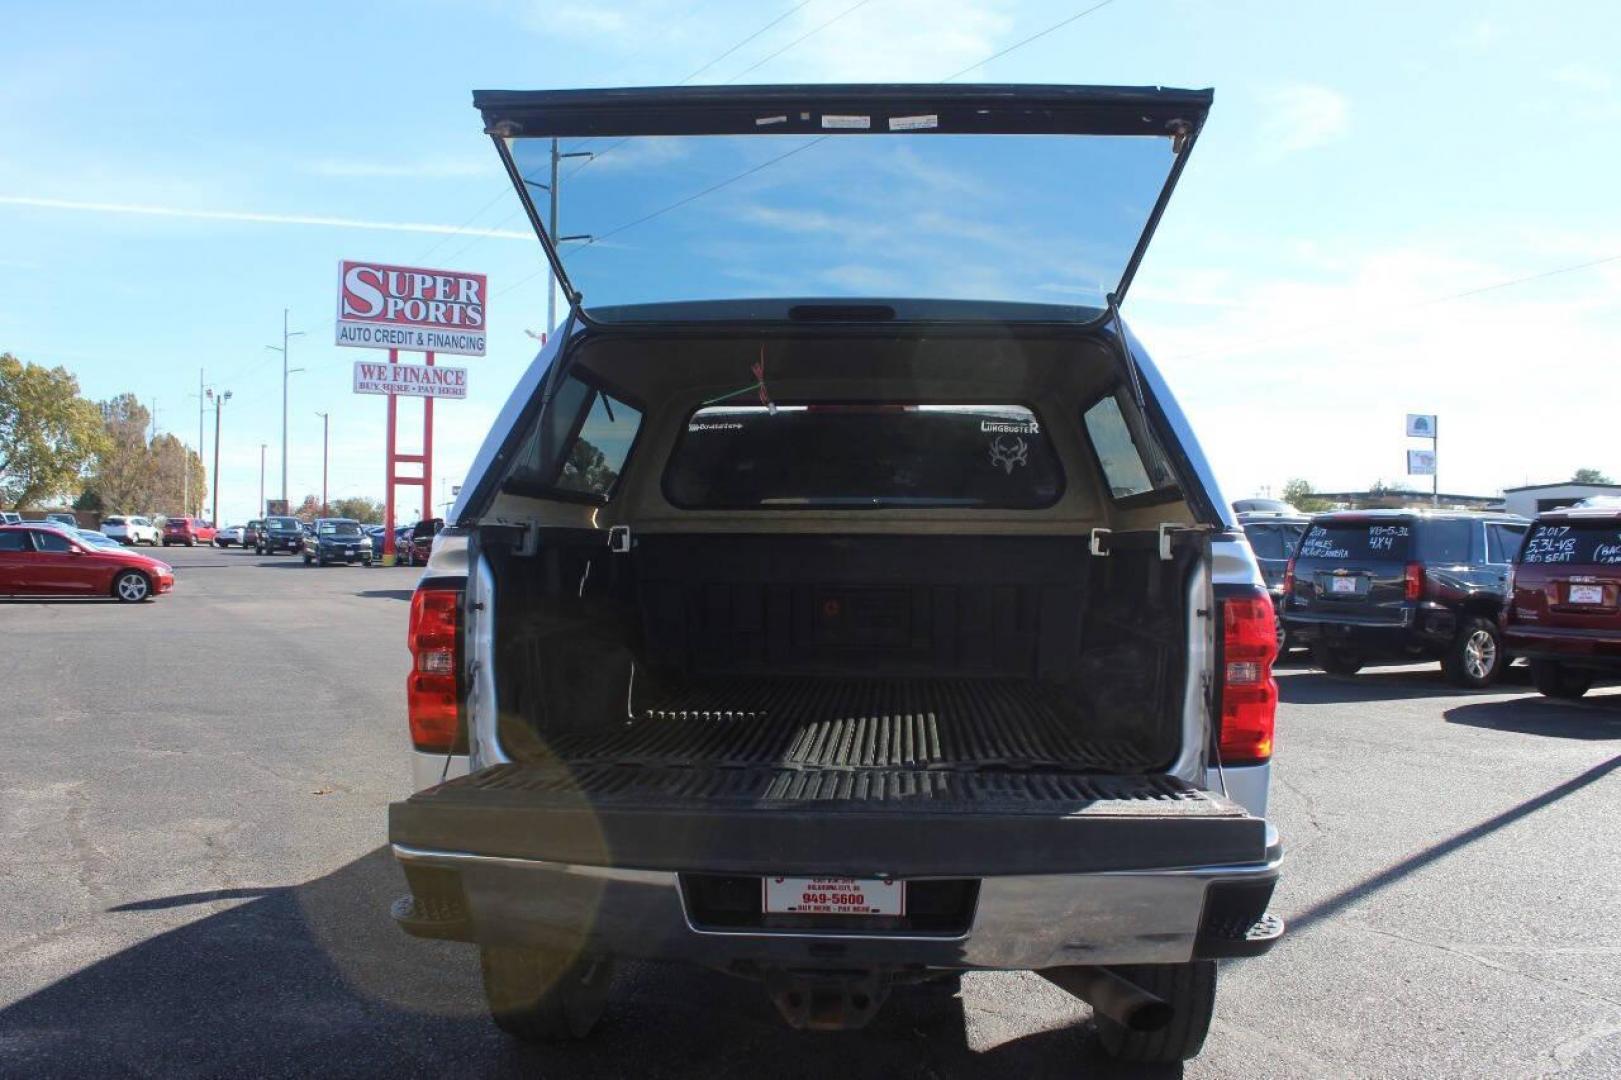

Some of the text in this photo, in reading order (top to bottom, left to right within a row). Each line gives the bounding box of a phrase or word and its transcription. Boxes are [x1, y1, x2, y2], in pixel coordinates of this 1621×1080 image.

[345, 266, 481, 317] SUPER
[340, 327, 484, 351] AUTO CREDIT & FINANCING
[360, 364, 465, 386] WE FINANCE
[359, 382, 465, 396] BUY HERE PAY HERE
[1536, 526, 1571, 537] 2017
[1545, 551, 1575, 563] SEAT
[802, 893, 864, 905] 949-5600
